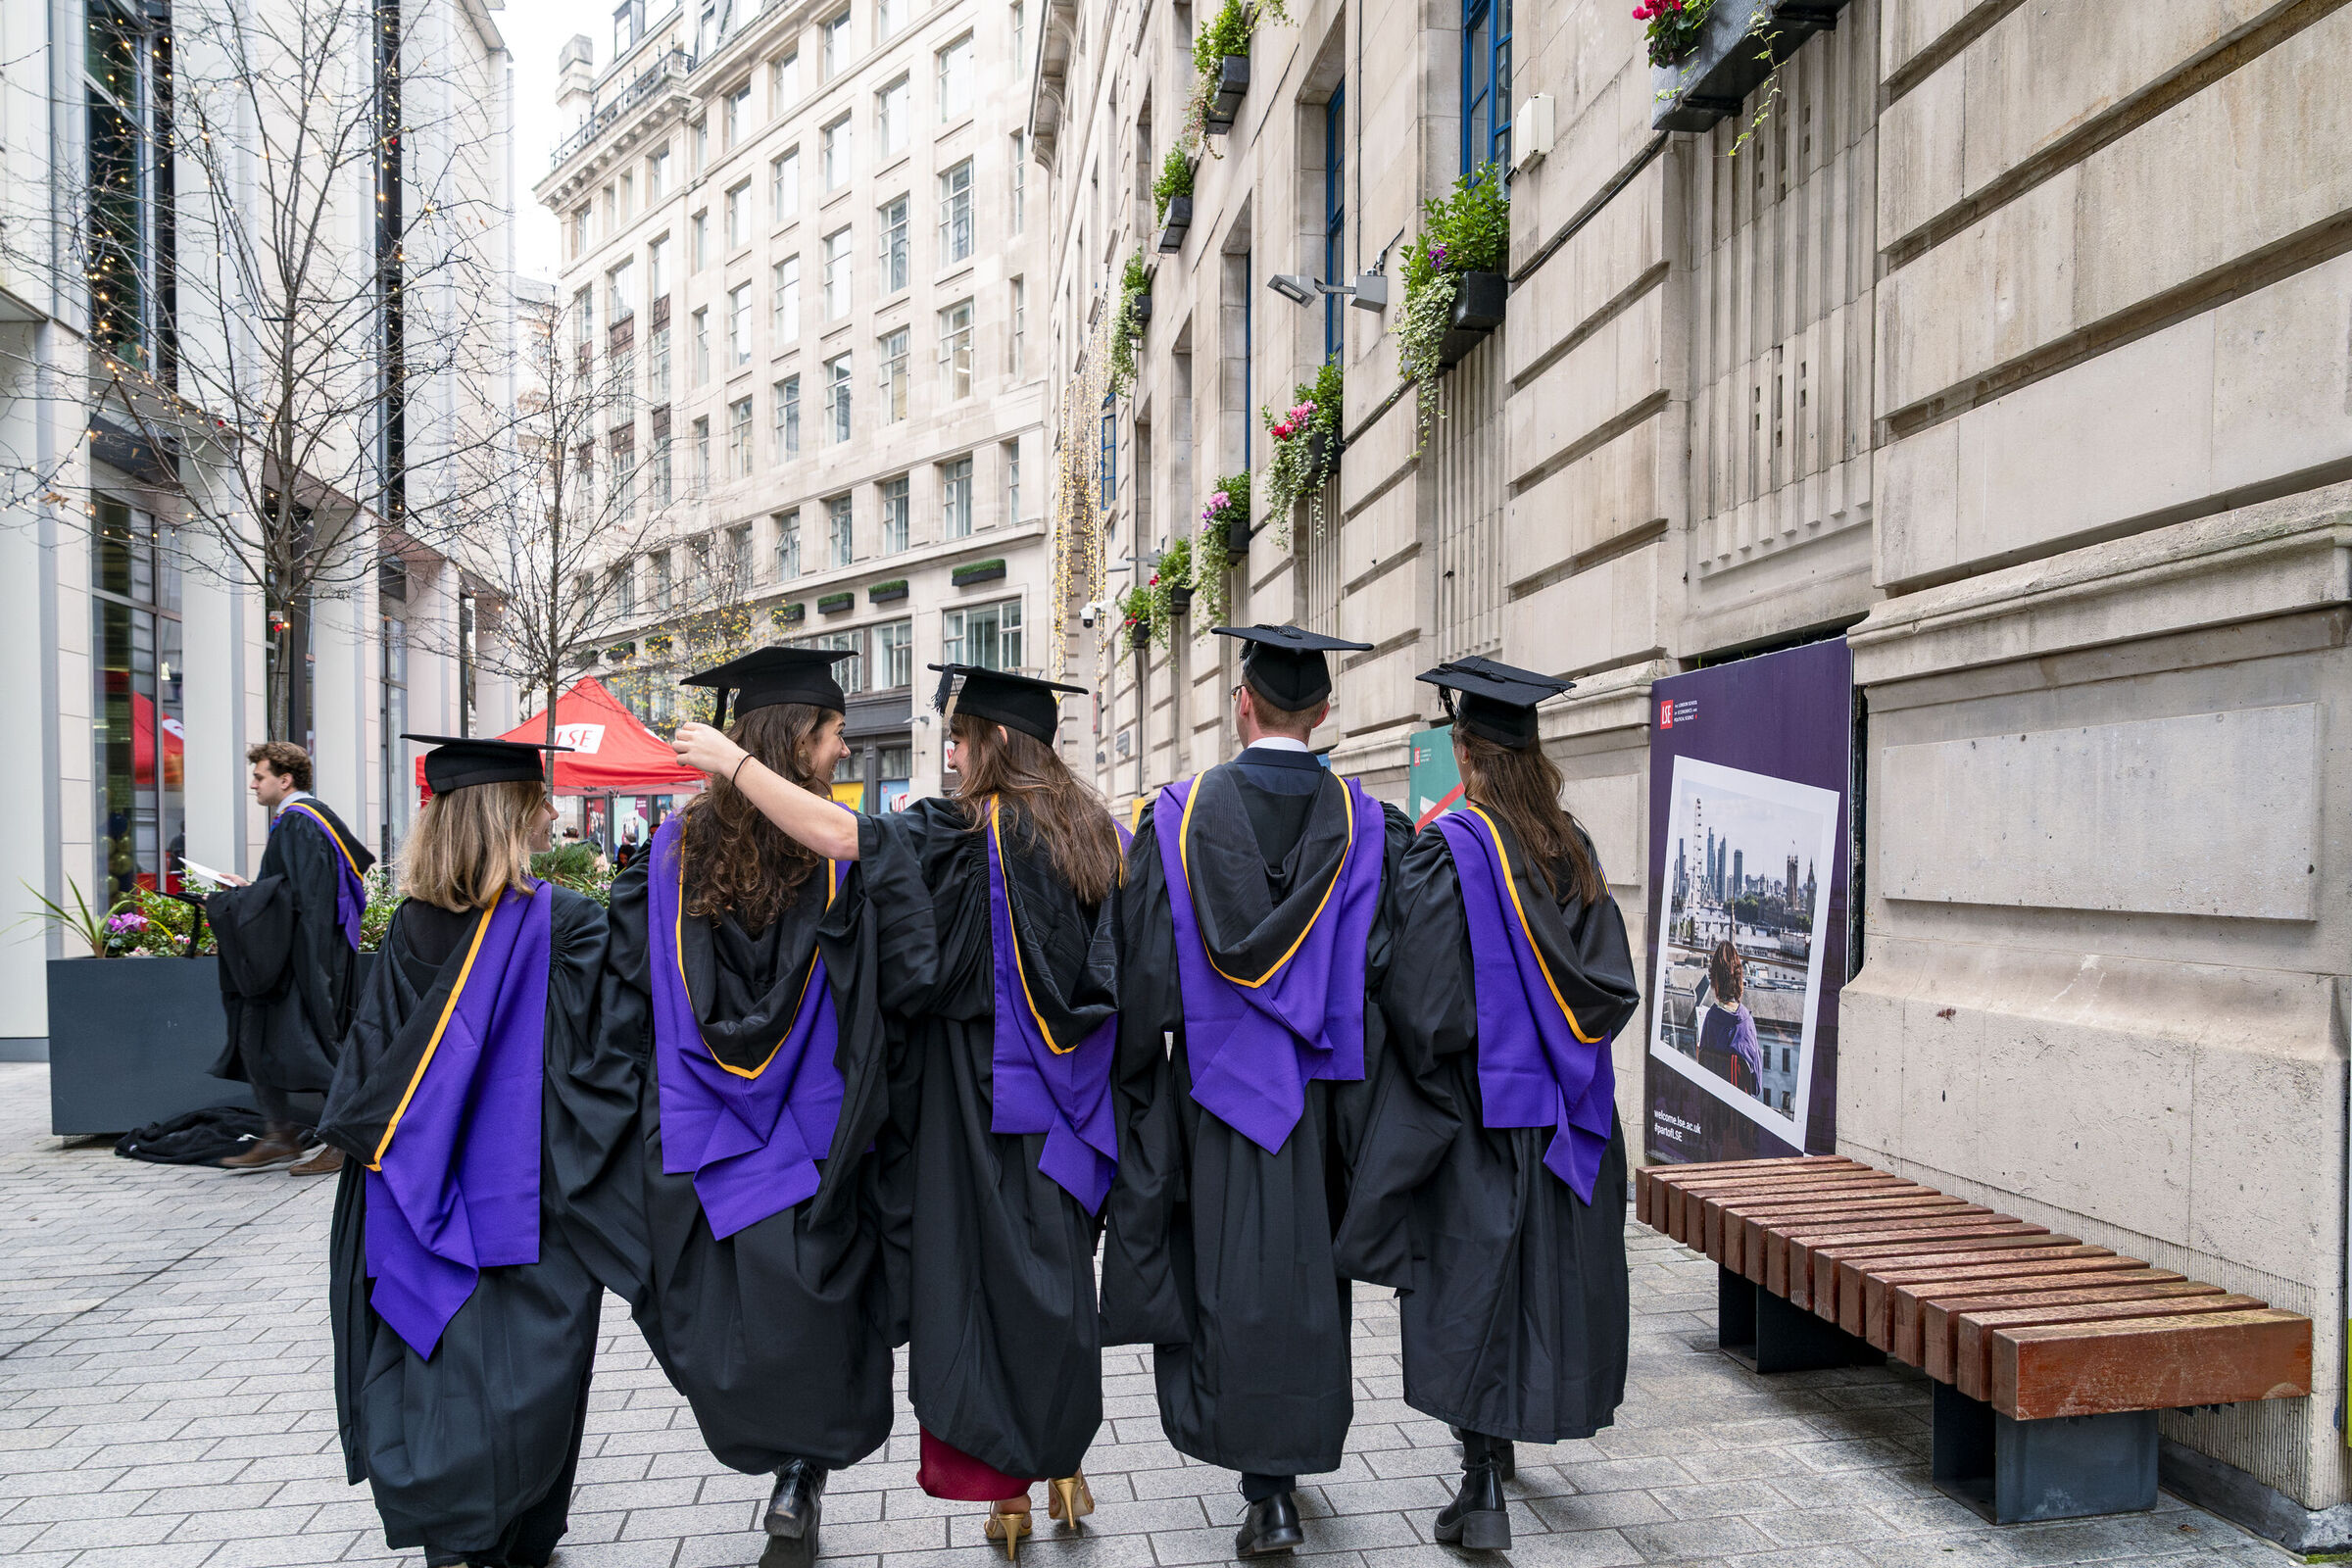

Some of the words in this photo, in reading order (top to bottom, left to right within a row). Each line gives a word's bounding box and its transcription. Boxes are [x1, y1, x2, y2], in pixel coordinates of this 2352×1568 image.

[1662, 705, 1671, 724] LSE
[1654, 1109, 1701, 1134] welcome.lse.ac.uk
[1654, 1122, 1683, 1142] #partofLSE
